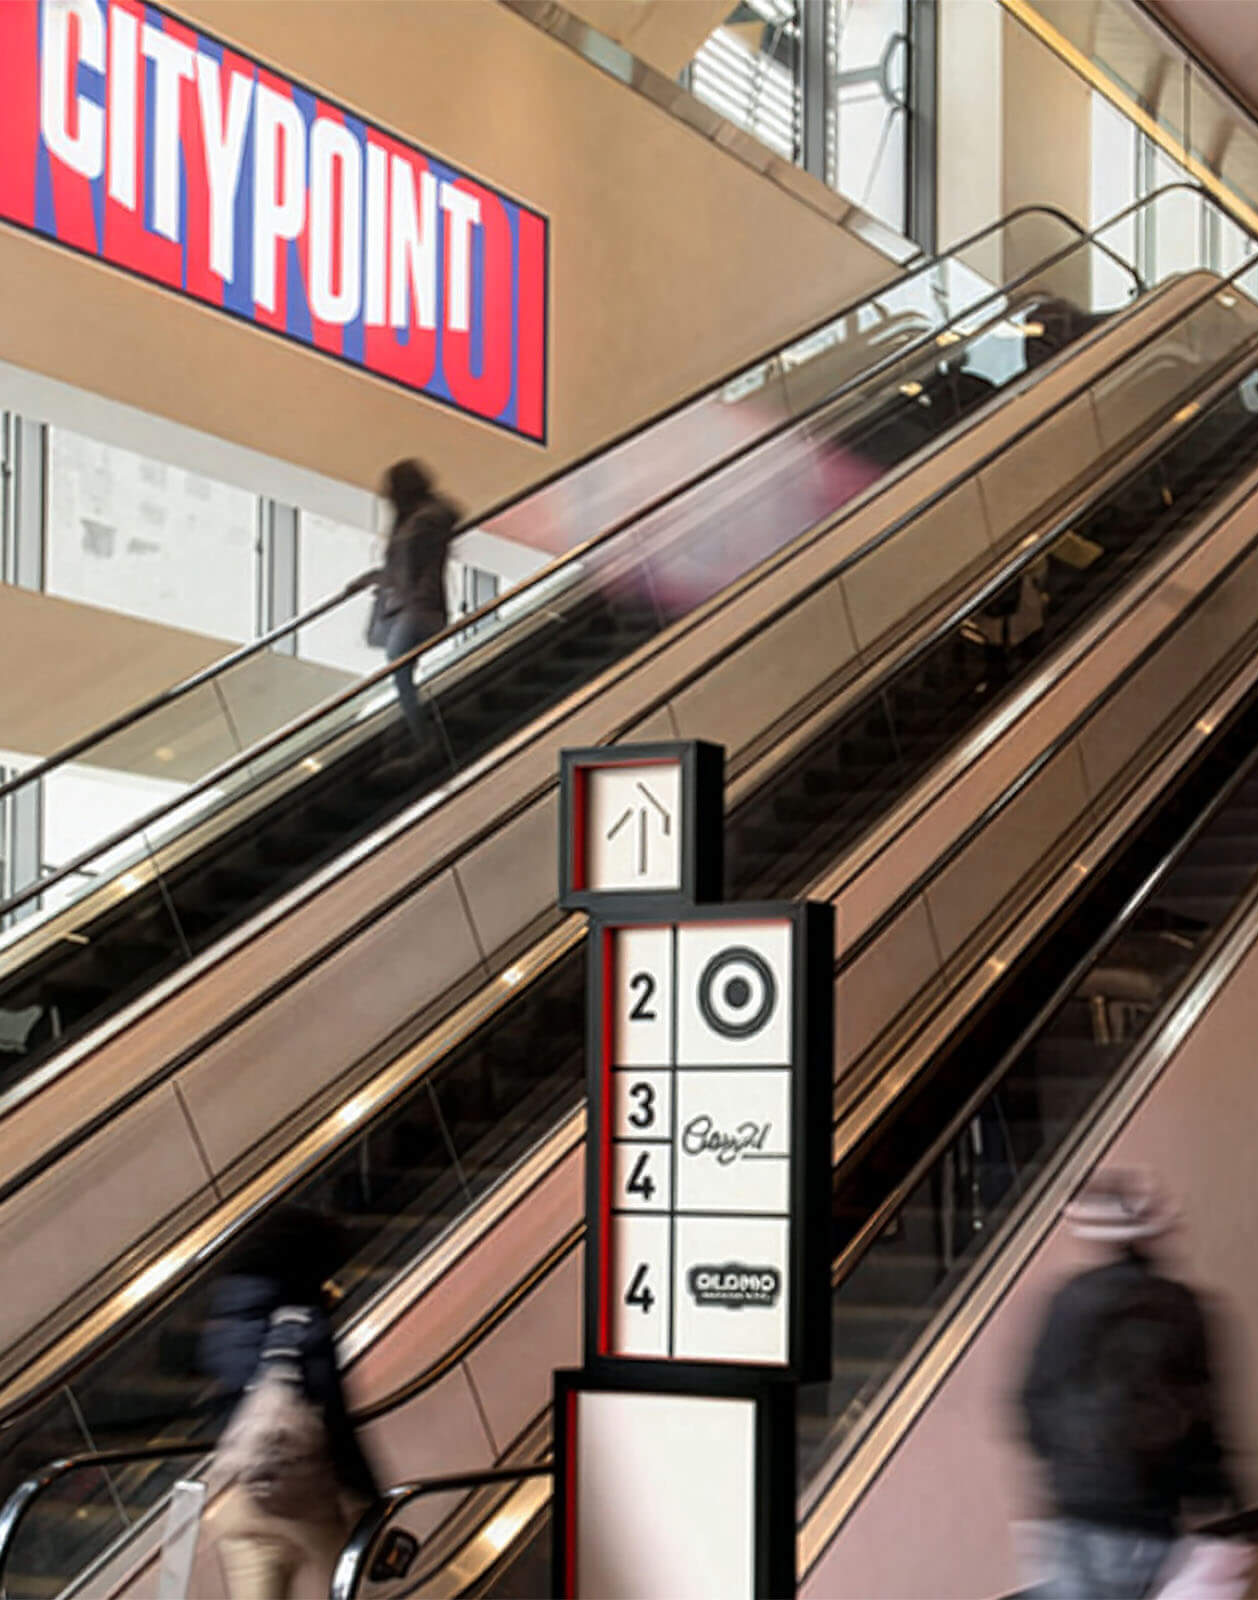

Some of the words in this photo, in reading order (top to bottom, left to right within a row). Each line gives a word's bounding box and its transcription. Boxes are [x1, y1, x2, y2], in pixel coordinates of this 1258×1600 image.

[39, 0, 483, 332] CITYPOINT
[628, 972, 657, 1022] 2
[628, 1081, 656, 1129] 3
[625, 1151, 656, 1200] 4
[624, 1263, 655, 1314] 4
